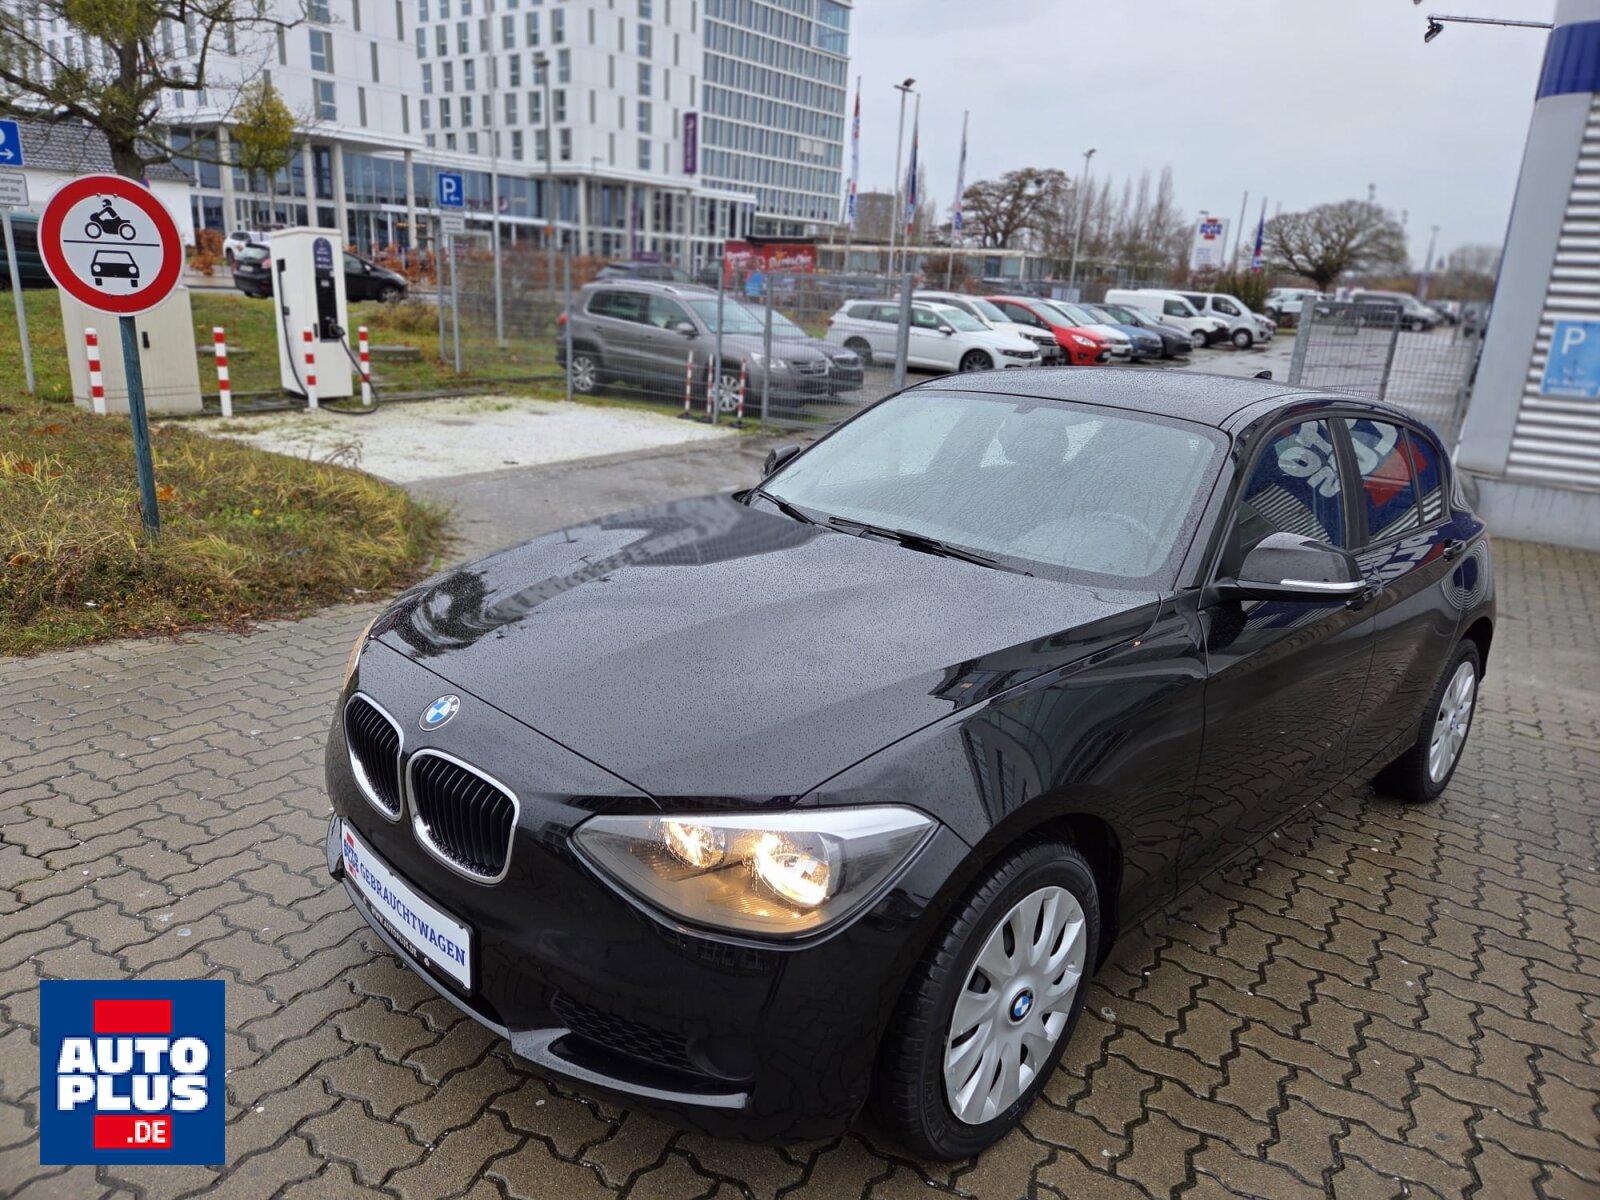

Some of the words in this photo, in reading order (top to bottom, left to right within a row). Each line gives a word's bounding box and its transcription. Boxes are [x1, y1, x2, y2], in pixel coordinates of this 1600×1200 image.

[442, 177, 456, 202] P
[1561, 327, 1586, 355] P
[360, 863, 466, 967] GEBRAUCHTWAGEN
